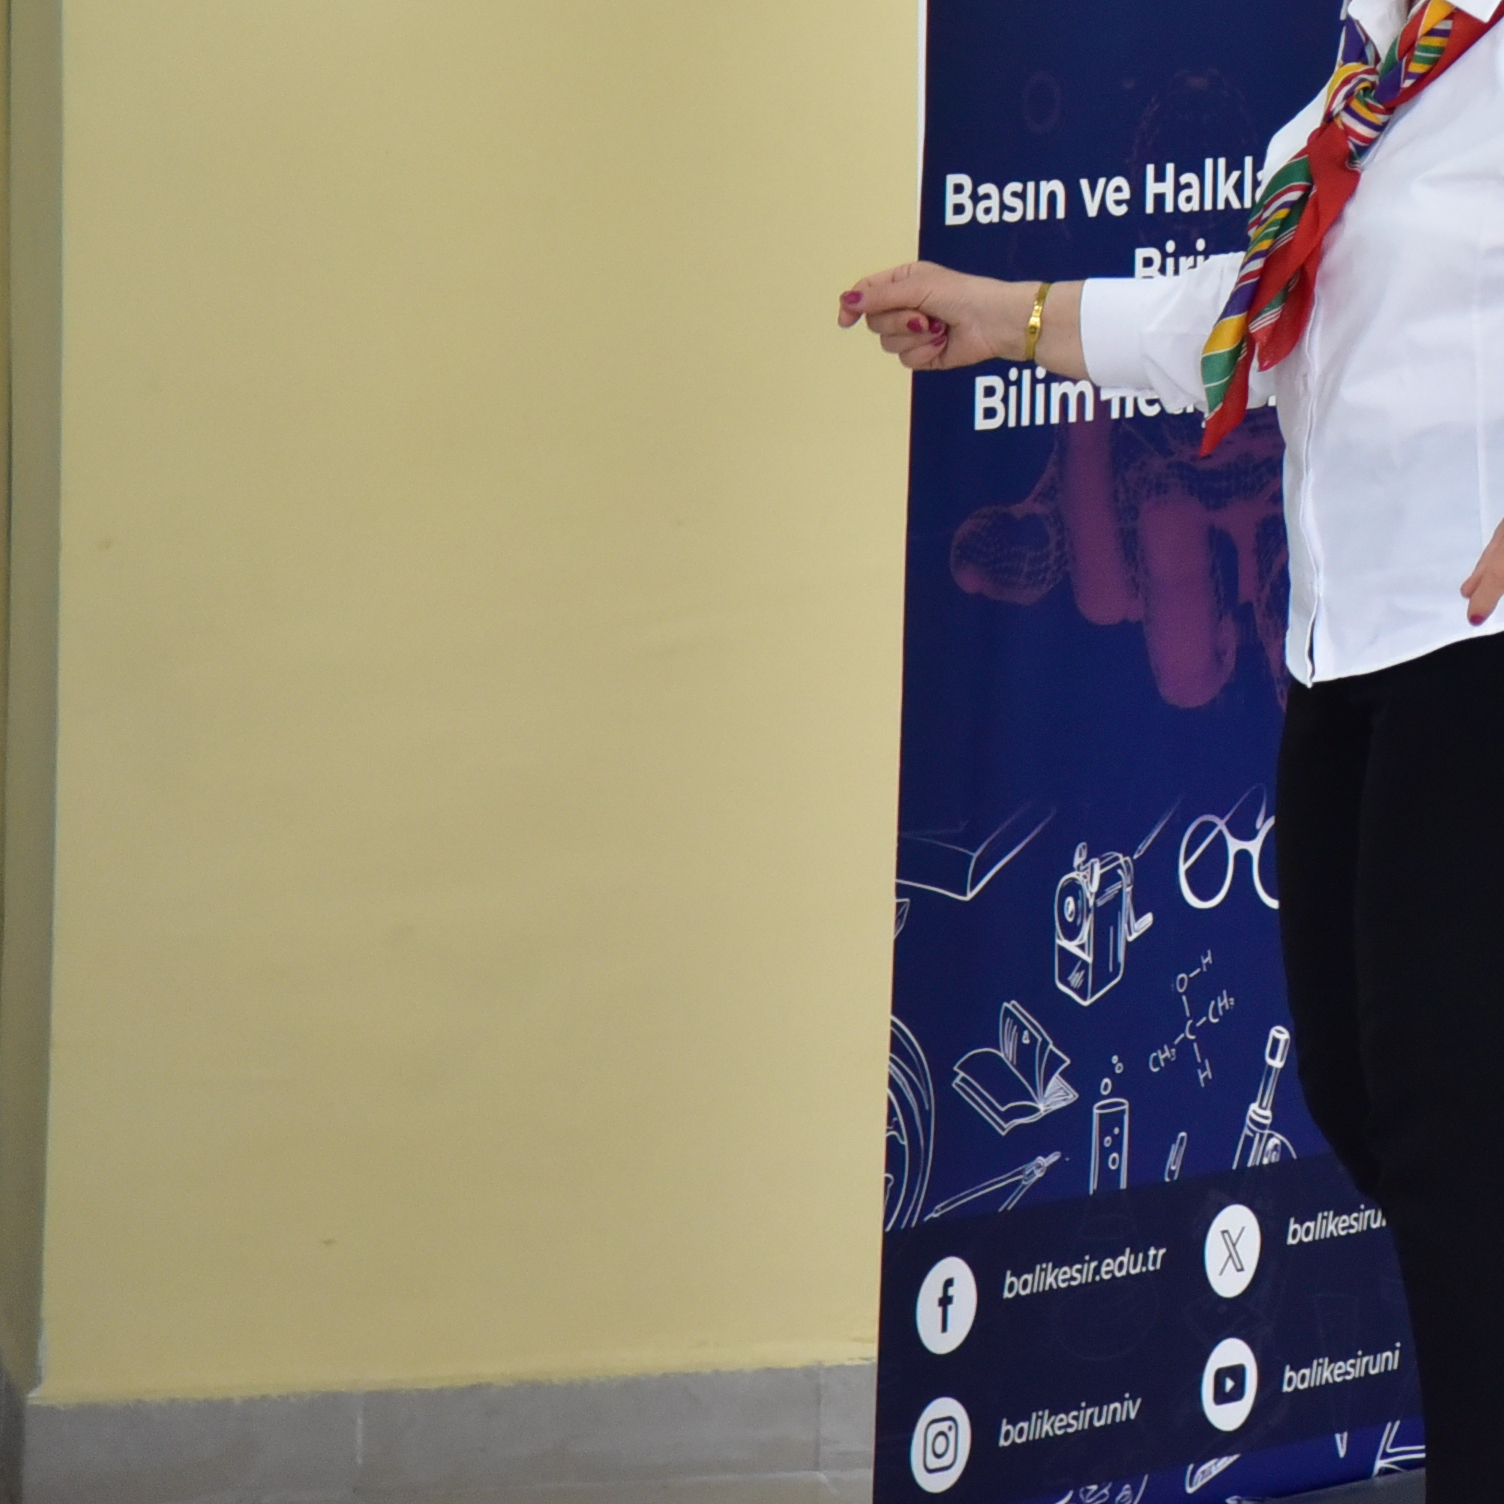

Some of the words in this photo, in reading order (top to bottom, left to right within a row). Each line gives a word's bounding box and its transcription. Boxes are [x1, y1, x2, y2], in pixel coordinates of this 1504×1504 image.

[945, 173, 1066, 226] Basın
[1080, 176, 1131, 218] ve
[974, 366, 1094, 431] Bilim
[1003, 1245, 1166, 1300] balikesir.edu.tr
[1282, 1342, 1401, 1393] balikesiruni
[999, 1393, 1142, 1448] balikesiruniv
